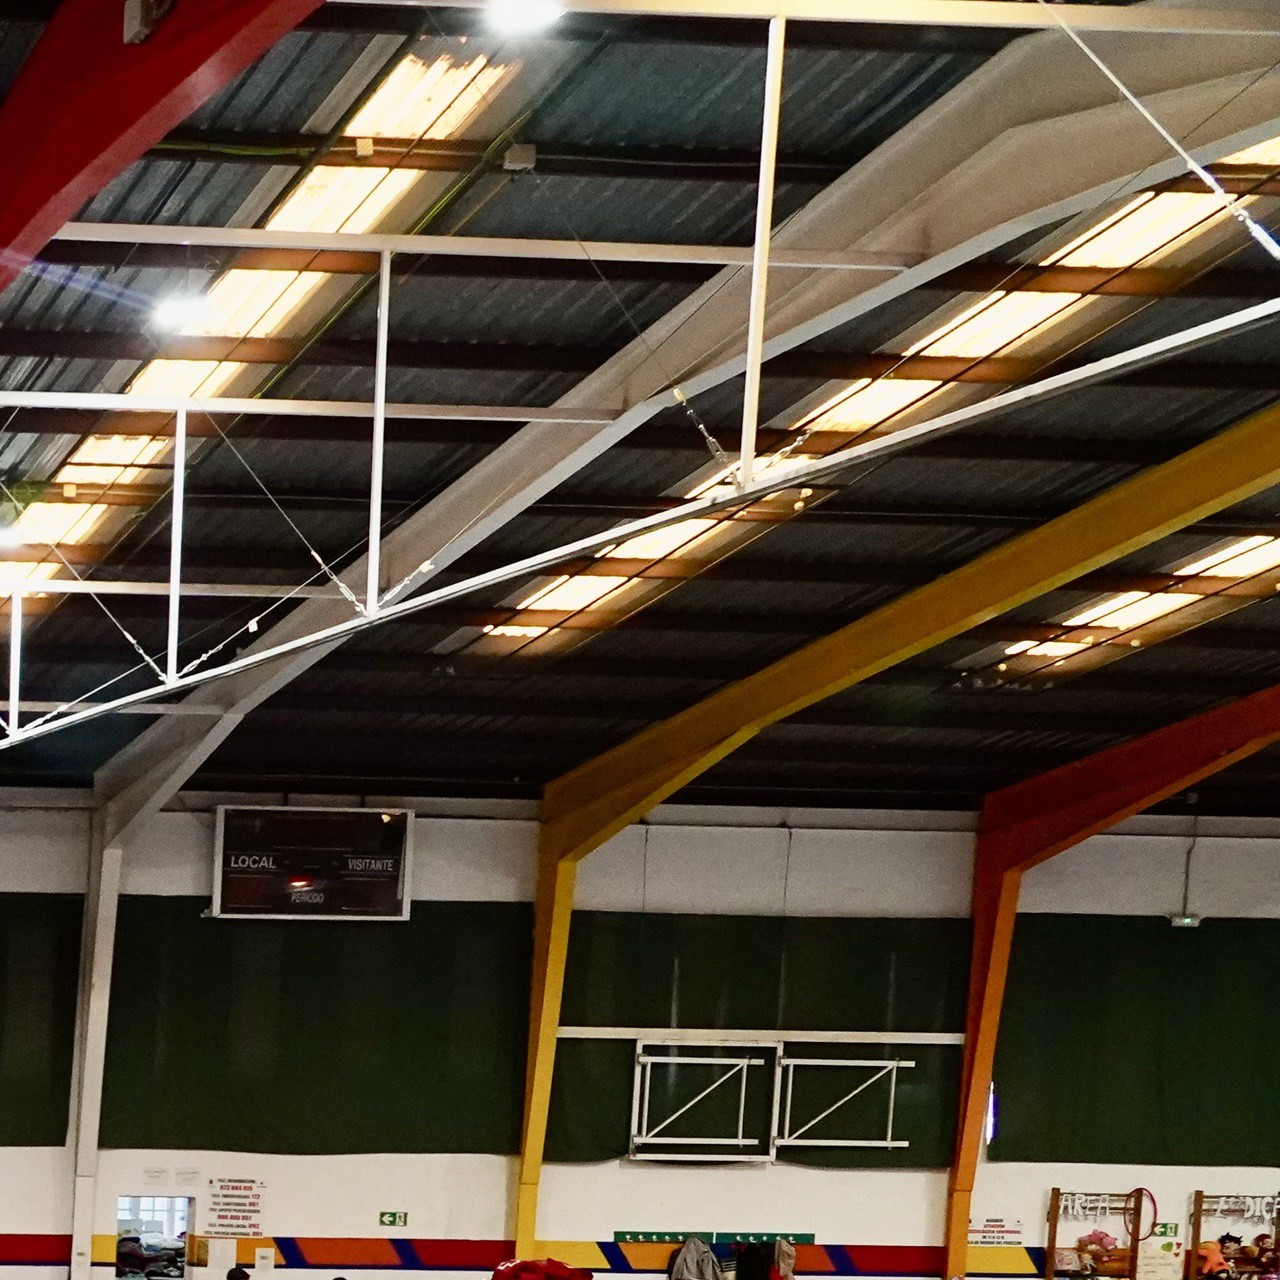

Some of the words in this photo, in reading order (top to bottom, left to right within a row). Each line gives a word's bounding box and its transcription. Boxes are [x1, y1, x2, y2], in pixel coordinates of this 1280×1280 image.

[231, 855, 277, 869] LOCAL
[348, 858, 394, 871] VISITANTE
[291, 892, 325, 904] PERIODO
